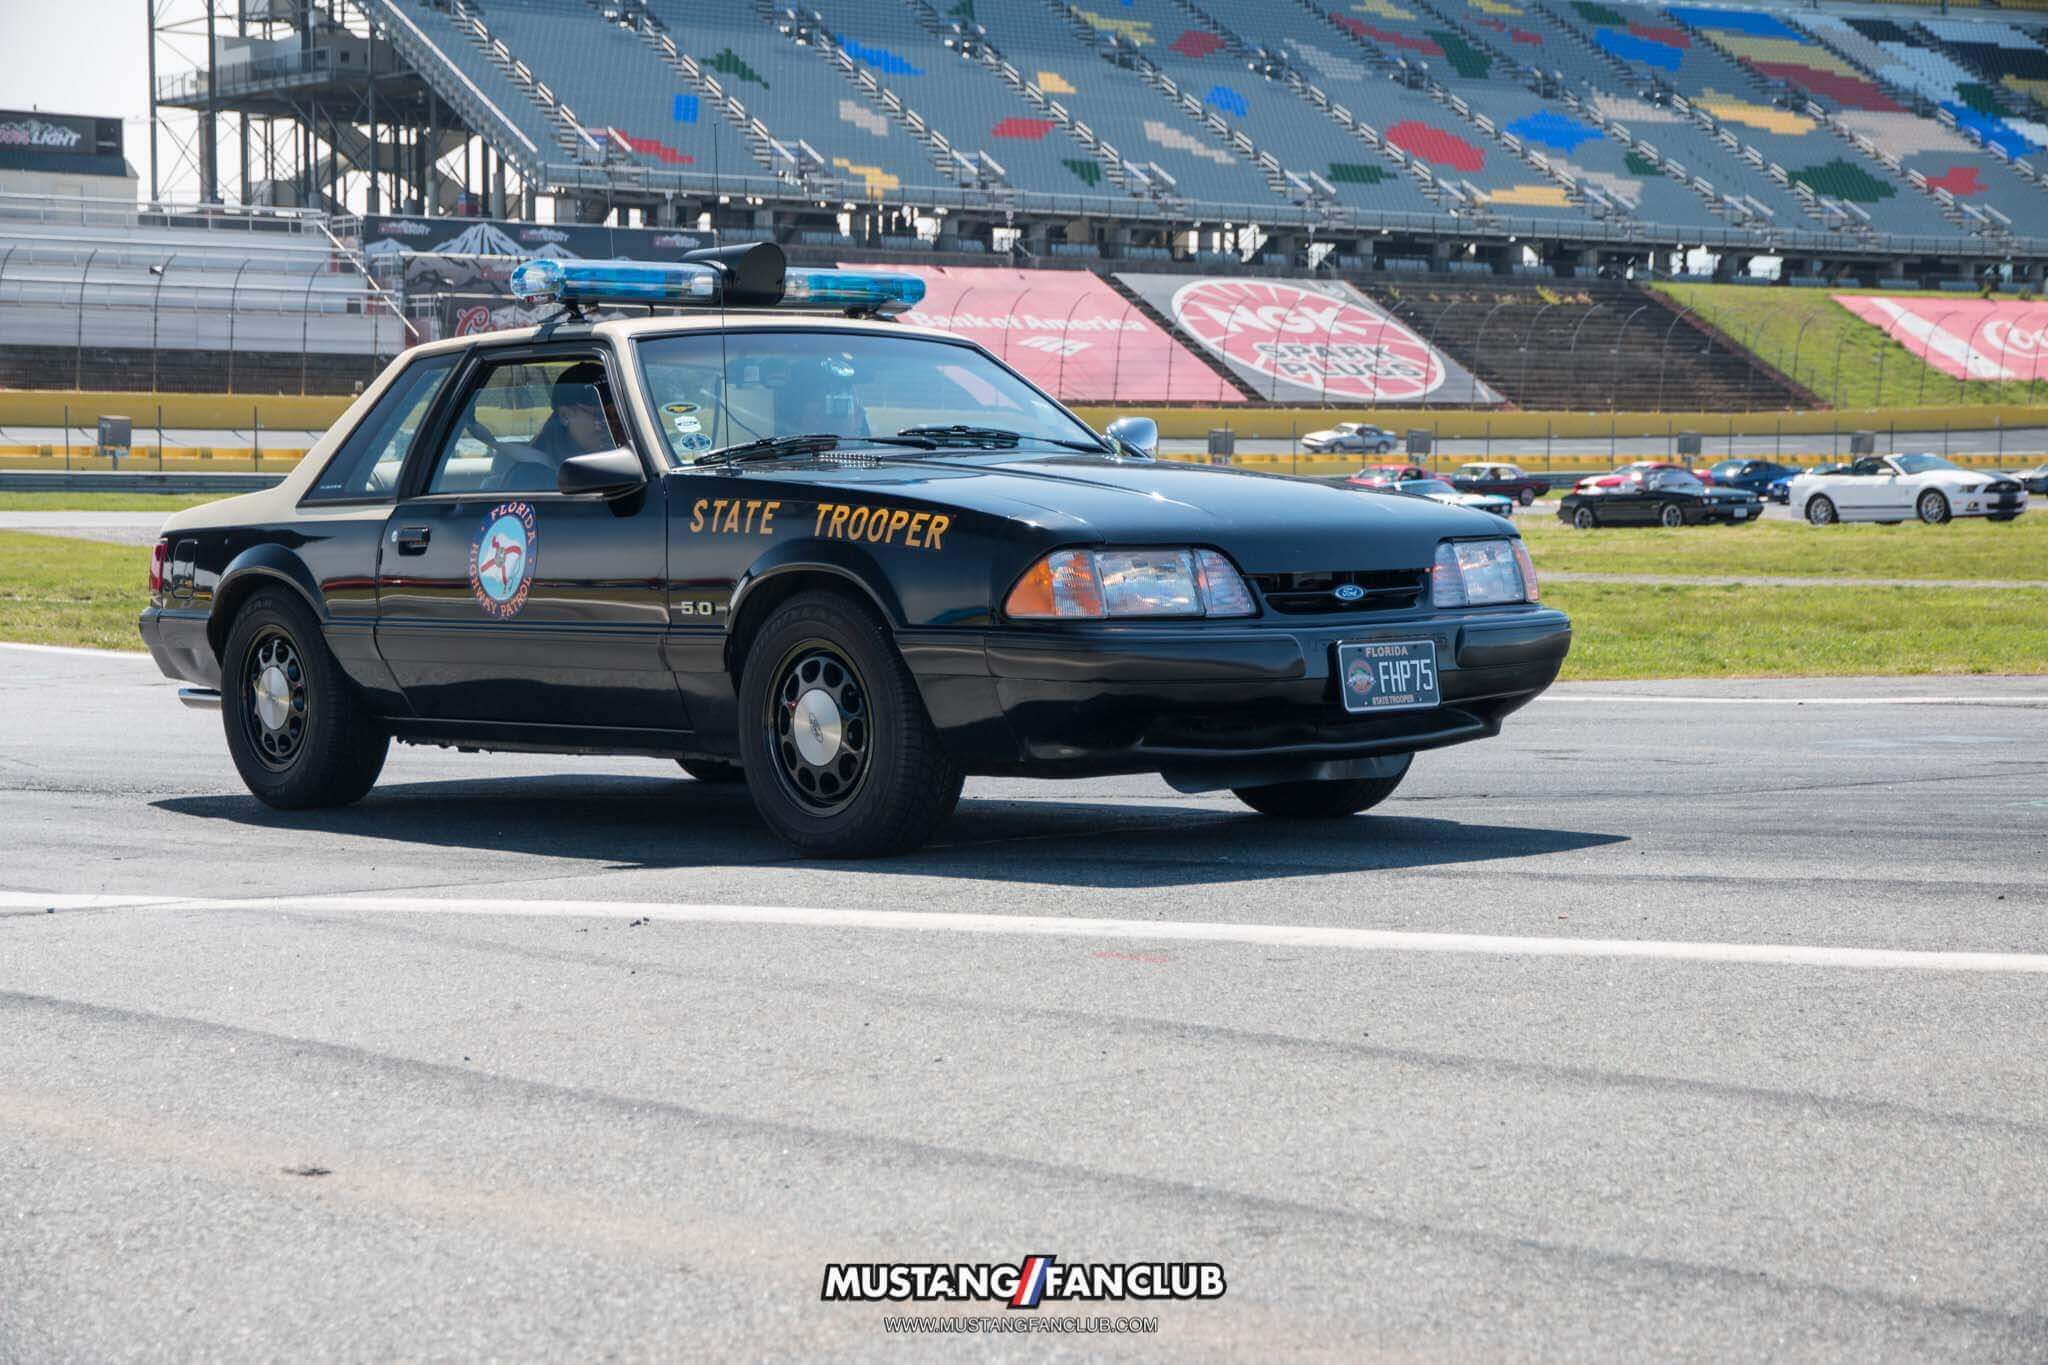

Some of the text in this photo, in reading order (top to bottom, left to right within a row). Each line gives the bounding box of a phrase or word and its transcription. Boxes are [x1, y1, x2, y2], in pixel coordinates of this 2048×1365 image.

[1200, 303, 1367, 336] NGK
[1254, 342, 1389, 361] SPARK
[1278, 361, 1427, 378] PLUGS
[490, 502, 536, 545] FLORIDA
[690, 499, 950, 550] STATE TROOPER
[500, 576, 532, 617] PATROL
[681, 601, 713, 615] 5.0
[1365, 646, 1409, 658] FLORIDA
[1379, 659, 1433, 694] FHP75
